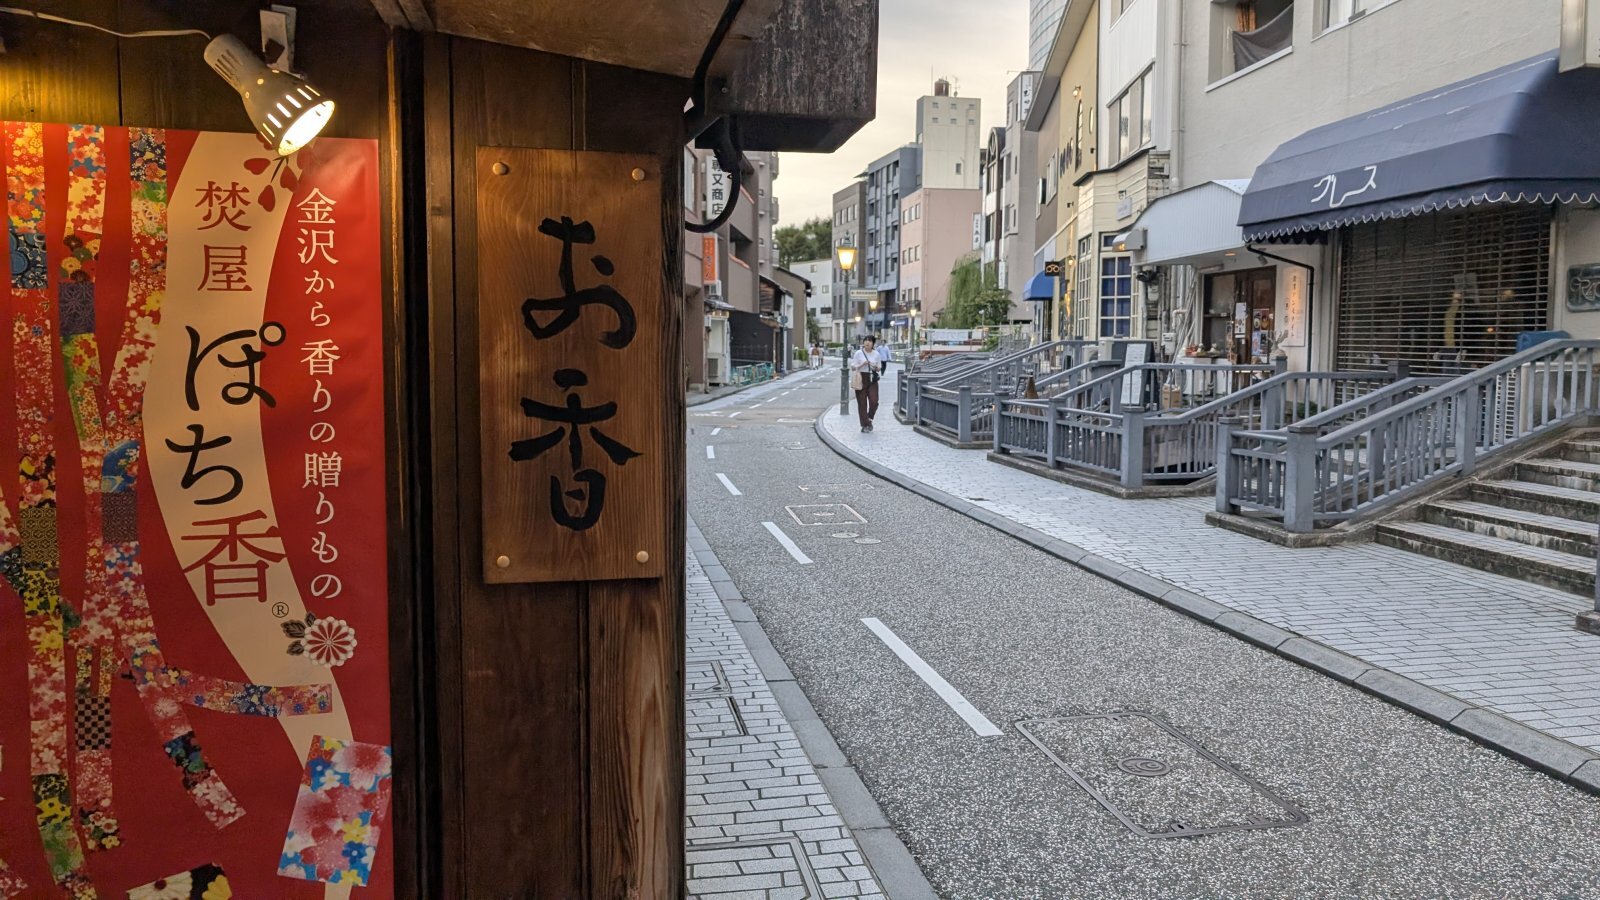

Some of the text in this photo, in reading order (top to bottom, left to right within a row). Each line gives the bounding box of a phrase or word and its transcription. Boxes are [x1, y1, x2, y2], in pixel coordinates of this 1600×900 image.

[195, 181, 253, 292] 焚屋
[508, 216, 644, 531] お香
[165, 322, 287, 606] ぽち香
[296, 187, 343, 599] 金沢から香りの贈りもの
